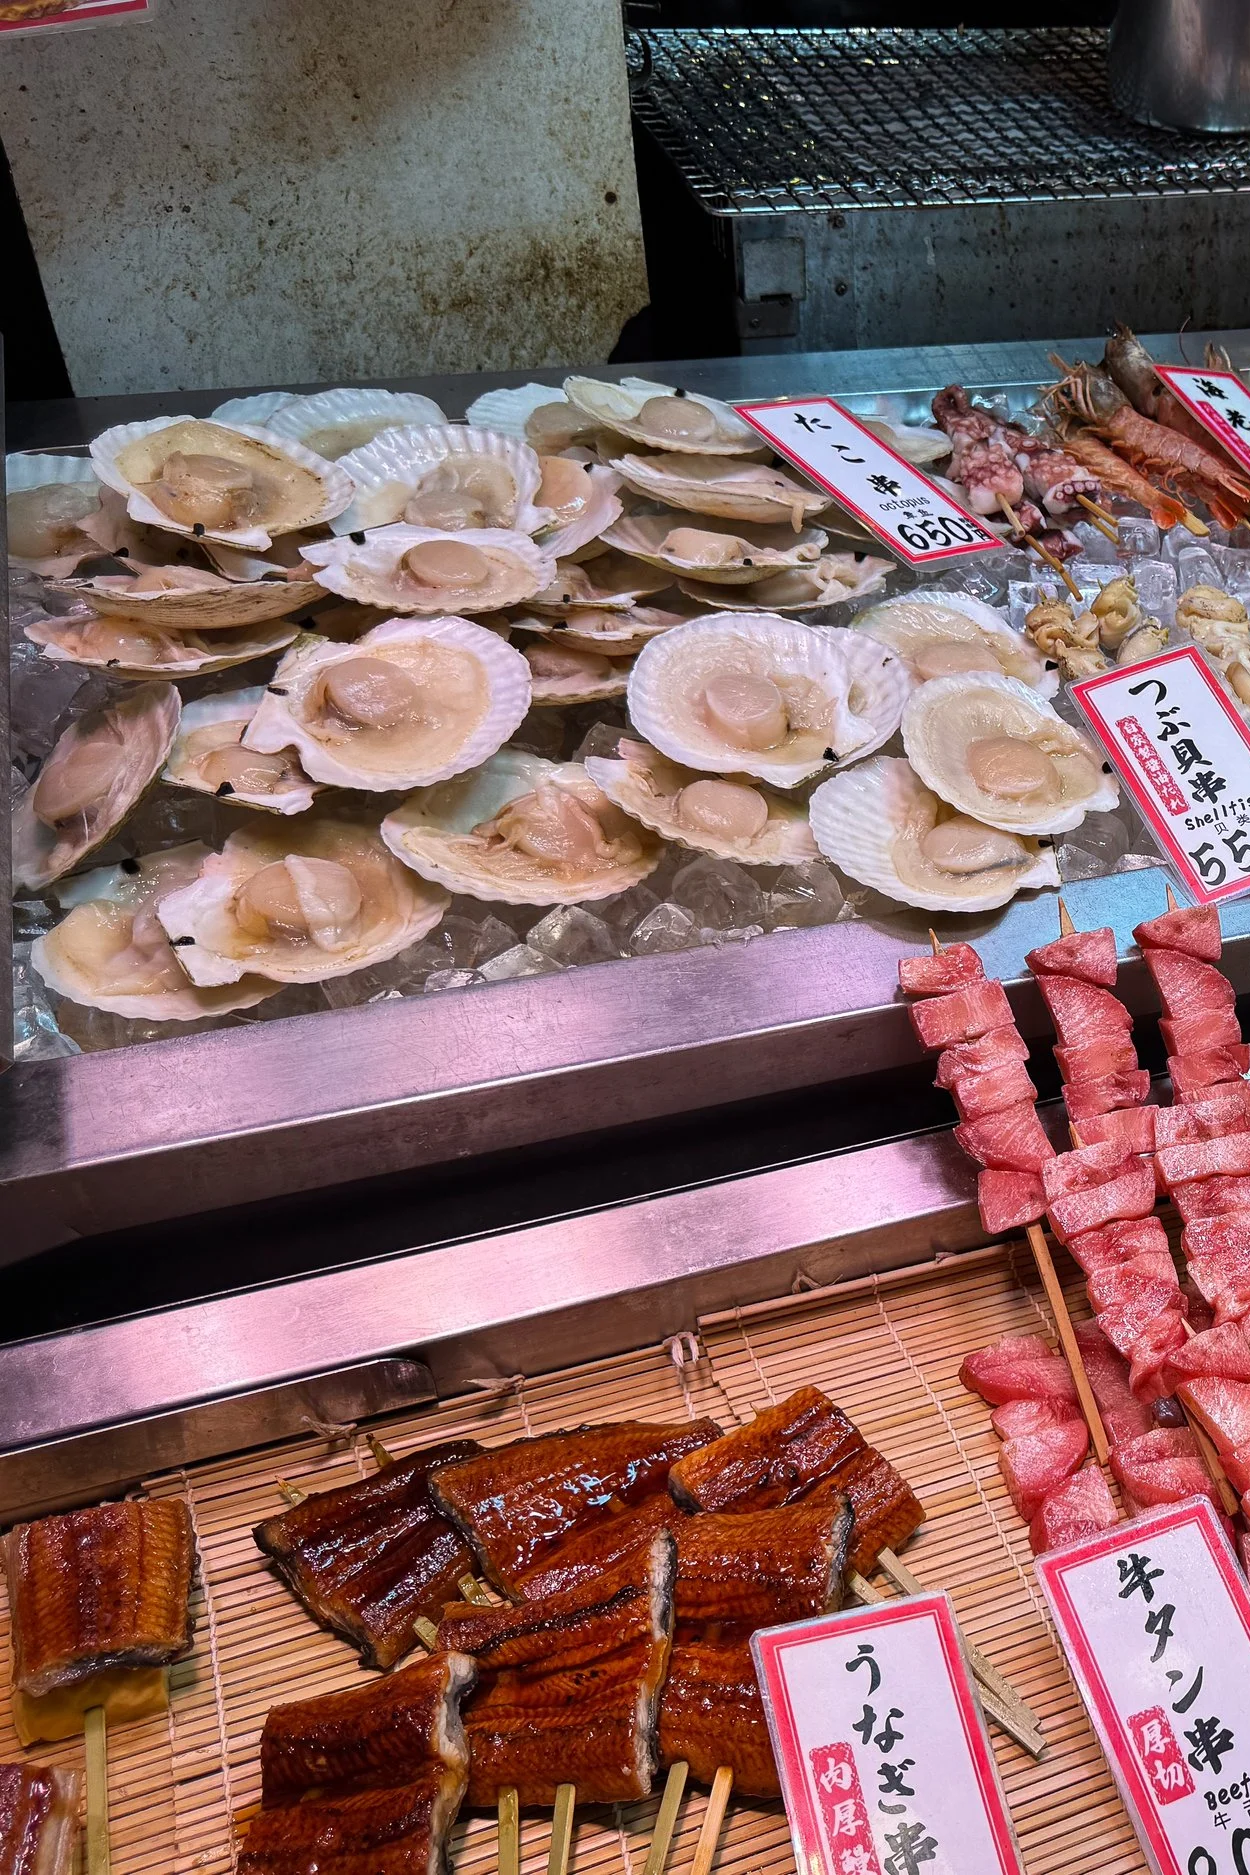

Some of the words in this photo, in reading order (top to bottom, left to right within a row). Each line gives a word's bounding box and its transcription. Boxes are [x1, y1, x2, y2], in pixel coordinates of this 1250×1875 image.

[794, 413, 901, 497] たこ串
[1128, 679, 1227, 804] つぶ貝串
[1117, 1553, 1234, 1775] 牛タン串
[845, 1644, 939, 1875] うなぎ串
[1138, 1718, 1186, 1791] 厚切
[1204, 1772, 1250, 1810] Beef
